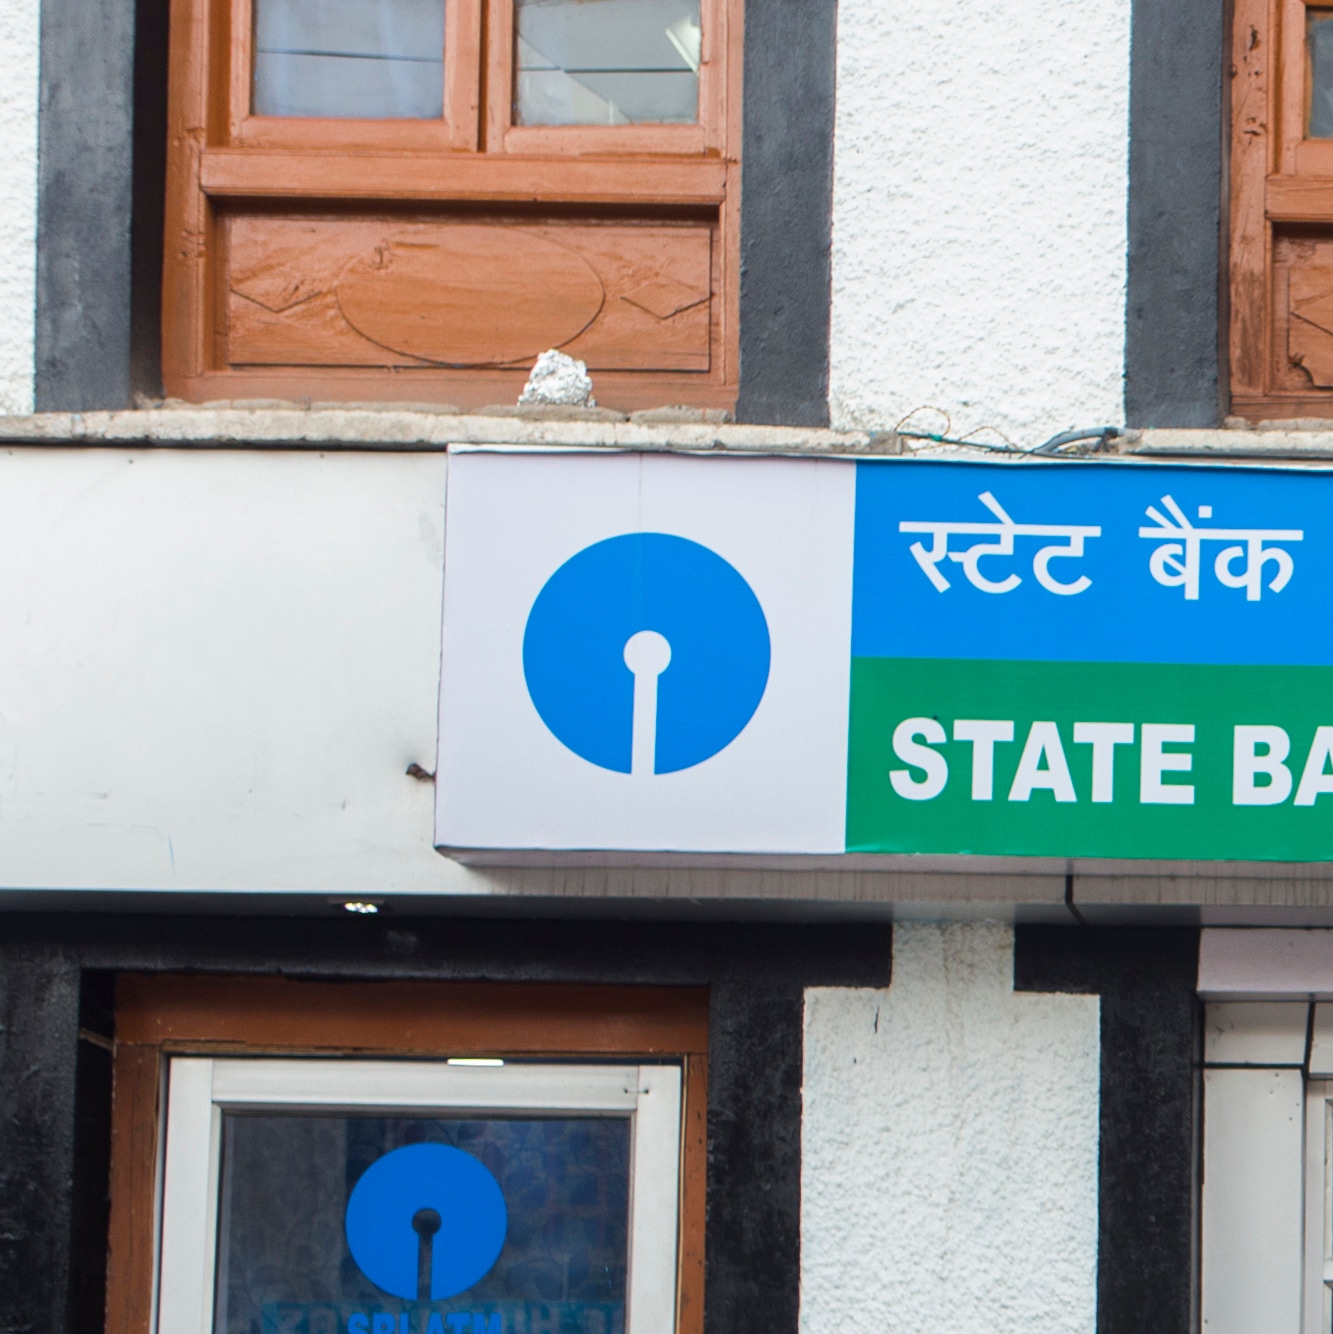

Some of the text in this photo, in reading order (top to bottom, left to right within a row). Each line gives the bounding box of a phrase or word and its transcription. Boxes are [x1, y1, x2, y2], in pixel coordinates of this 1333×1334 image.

[898, 491, 1102, 597] स्टेट
[1138, 494, 1305, 602] बैंक
[889, 716, 1196, 806] STATE
